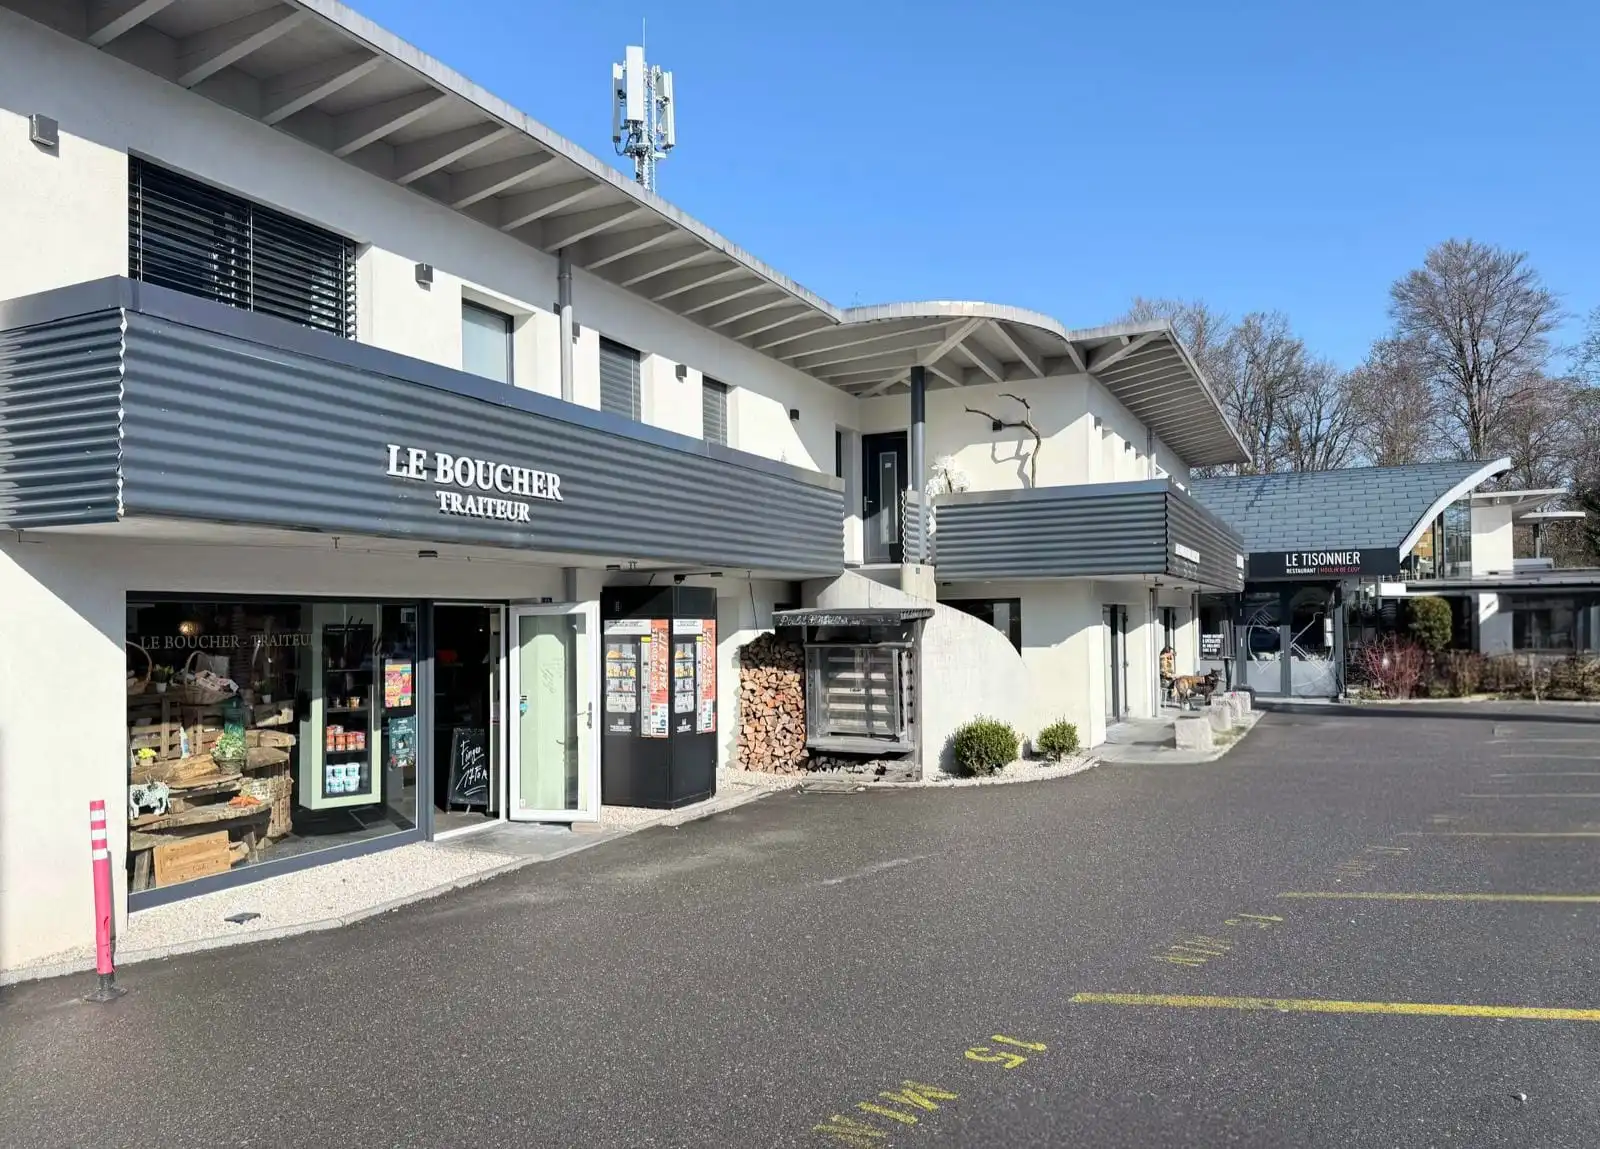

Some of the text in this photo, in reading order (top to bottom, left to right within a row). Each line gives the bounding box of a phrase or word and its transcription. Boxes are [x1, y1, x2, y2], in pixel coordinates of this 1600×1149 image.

[386, 444, 564, 502] LE BOUCHER
[436, 490, 531, 522] TRAITEUR
[1286, 551, 1361, 567] LE TISONNIER
[140, 636, 160, 650] LE
[164, 635, 240, 649] BOUCHER
[964, 1034, 1048, 1070] 15
